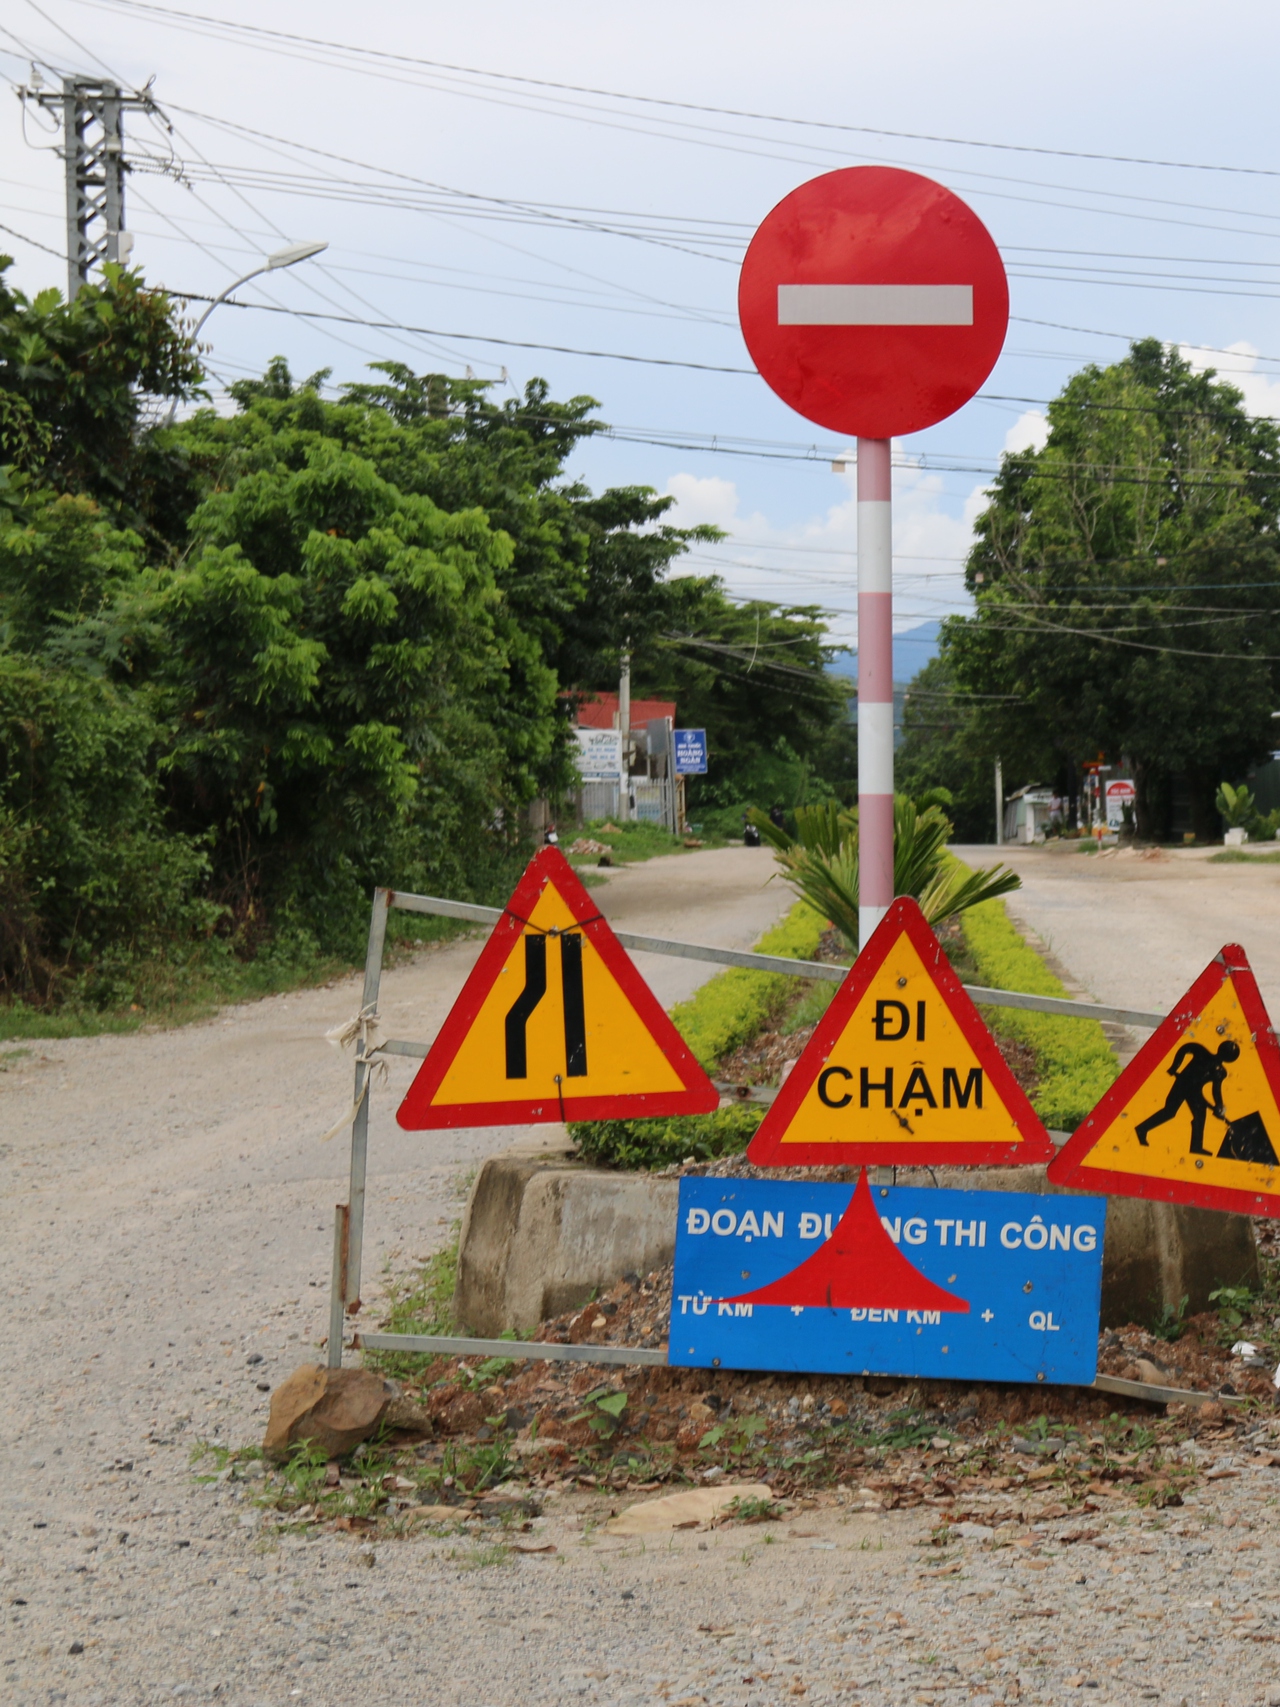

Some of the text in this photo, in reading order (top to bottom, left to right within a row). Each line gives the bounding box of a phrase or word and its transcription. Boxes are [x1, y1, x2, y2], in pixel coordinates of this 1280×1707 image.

[872, 999, 926, 1042] ĐI
[817, 1060, 984, 1116] CHẬM
[686, 1207, 785, 1243] ĐOẠN
[934, 1219, 987, 1248] THI
[1000, 1214, 1097, 1253] CÔNG
[1028, 1310, 1061, 1332] QL
